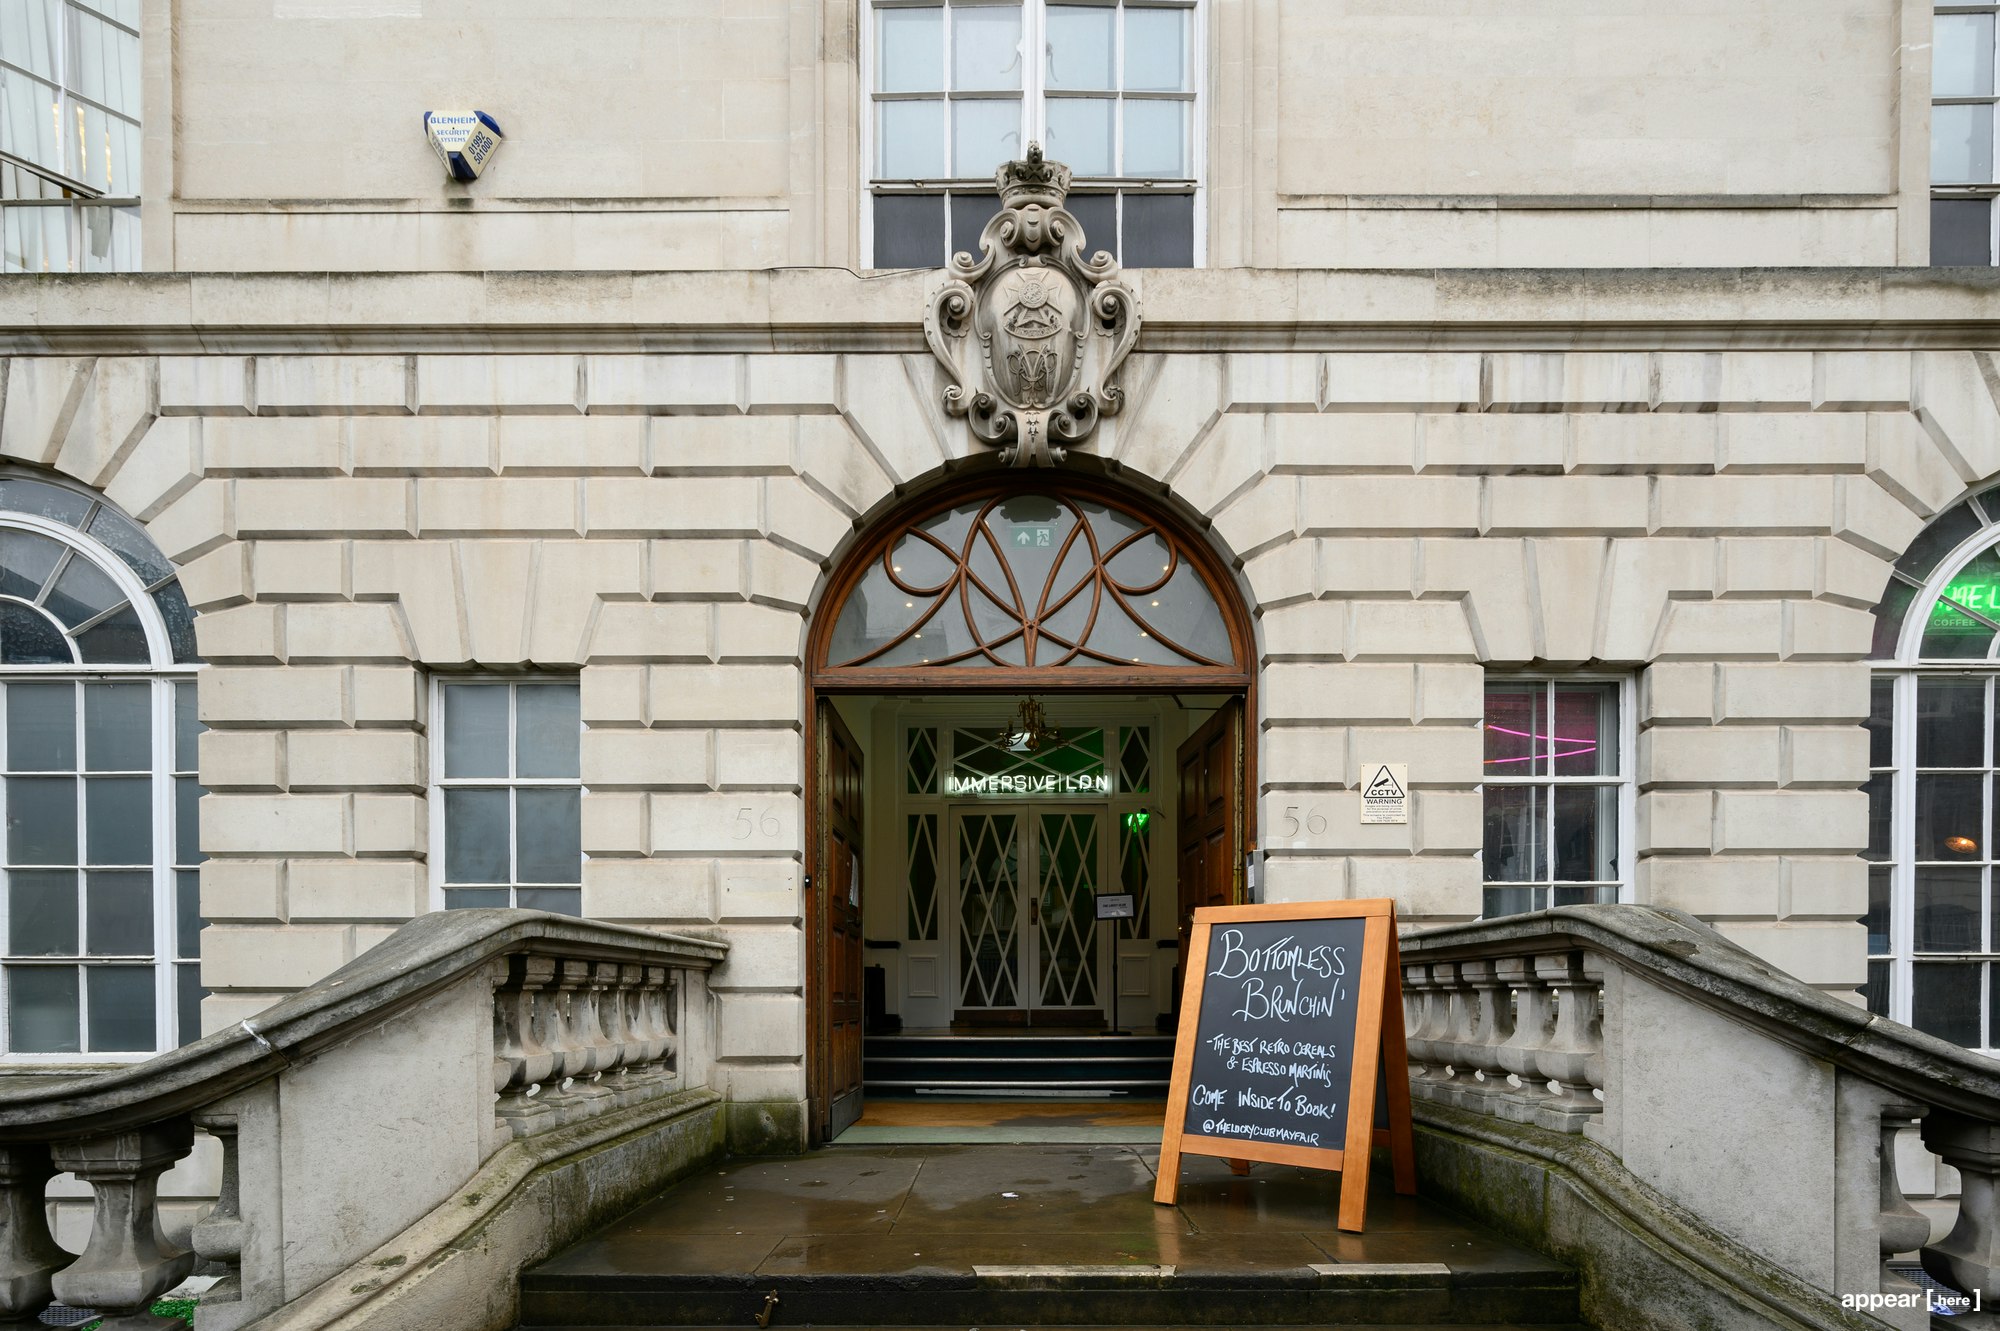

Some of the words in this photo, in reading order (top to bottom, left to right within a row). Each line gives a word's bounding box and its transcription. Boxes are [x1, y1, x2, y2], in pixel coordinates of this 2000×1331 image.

[468, 131, 486, 155] 01992
[474, 136, 494, 165] 501000
[1933, 618, 1977, 627] COFFEE
[731, 805, 782, 840] 56
[1280, 804, 1327, 838] 56
[1208, 929, 1345, 981] BOTTOMLESS
[1232, 1037, 1259, 1056] BEST
[1259, 1037, 1290, 1056] RETRO
[1293, 1041, 1336, 1059] CEREALS
[1226, 1055, 1239, 1070] &
[1241, 1056, 1287, 1076] ESPRESSO
[1192, 1084, 1228, 1111] COME
[1238, 1087, 1277, 1110] INSIDE
[1276, 1085, 1294, 1112] TO
[1294, 1094, 1337, 1120] BOOK!
